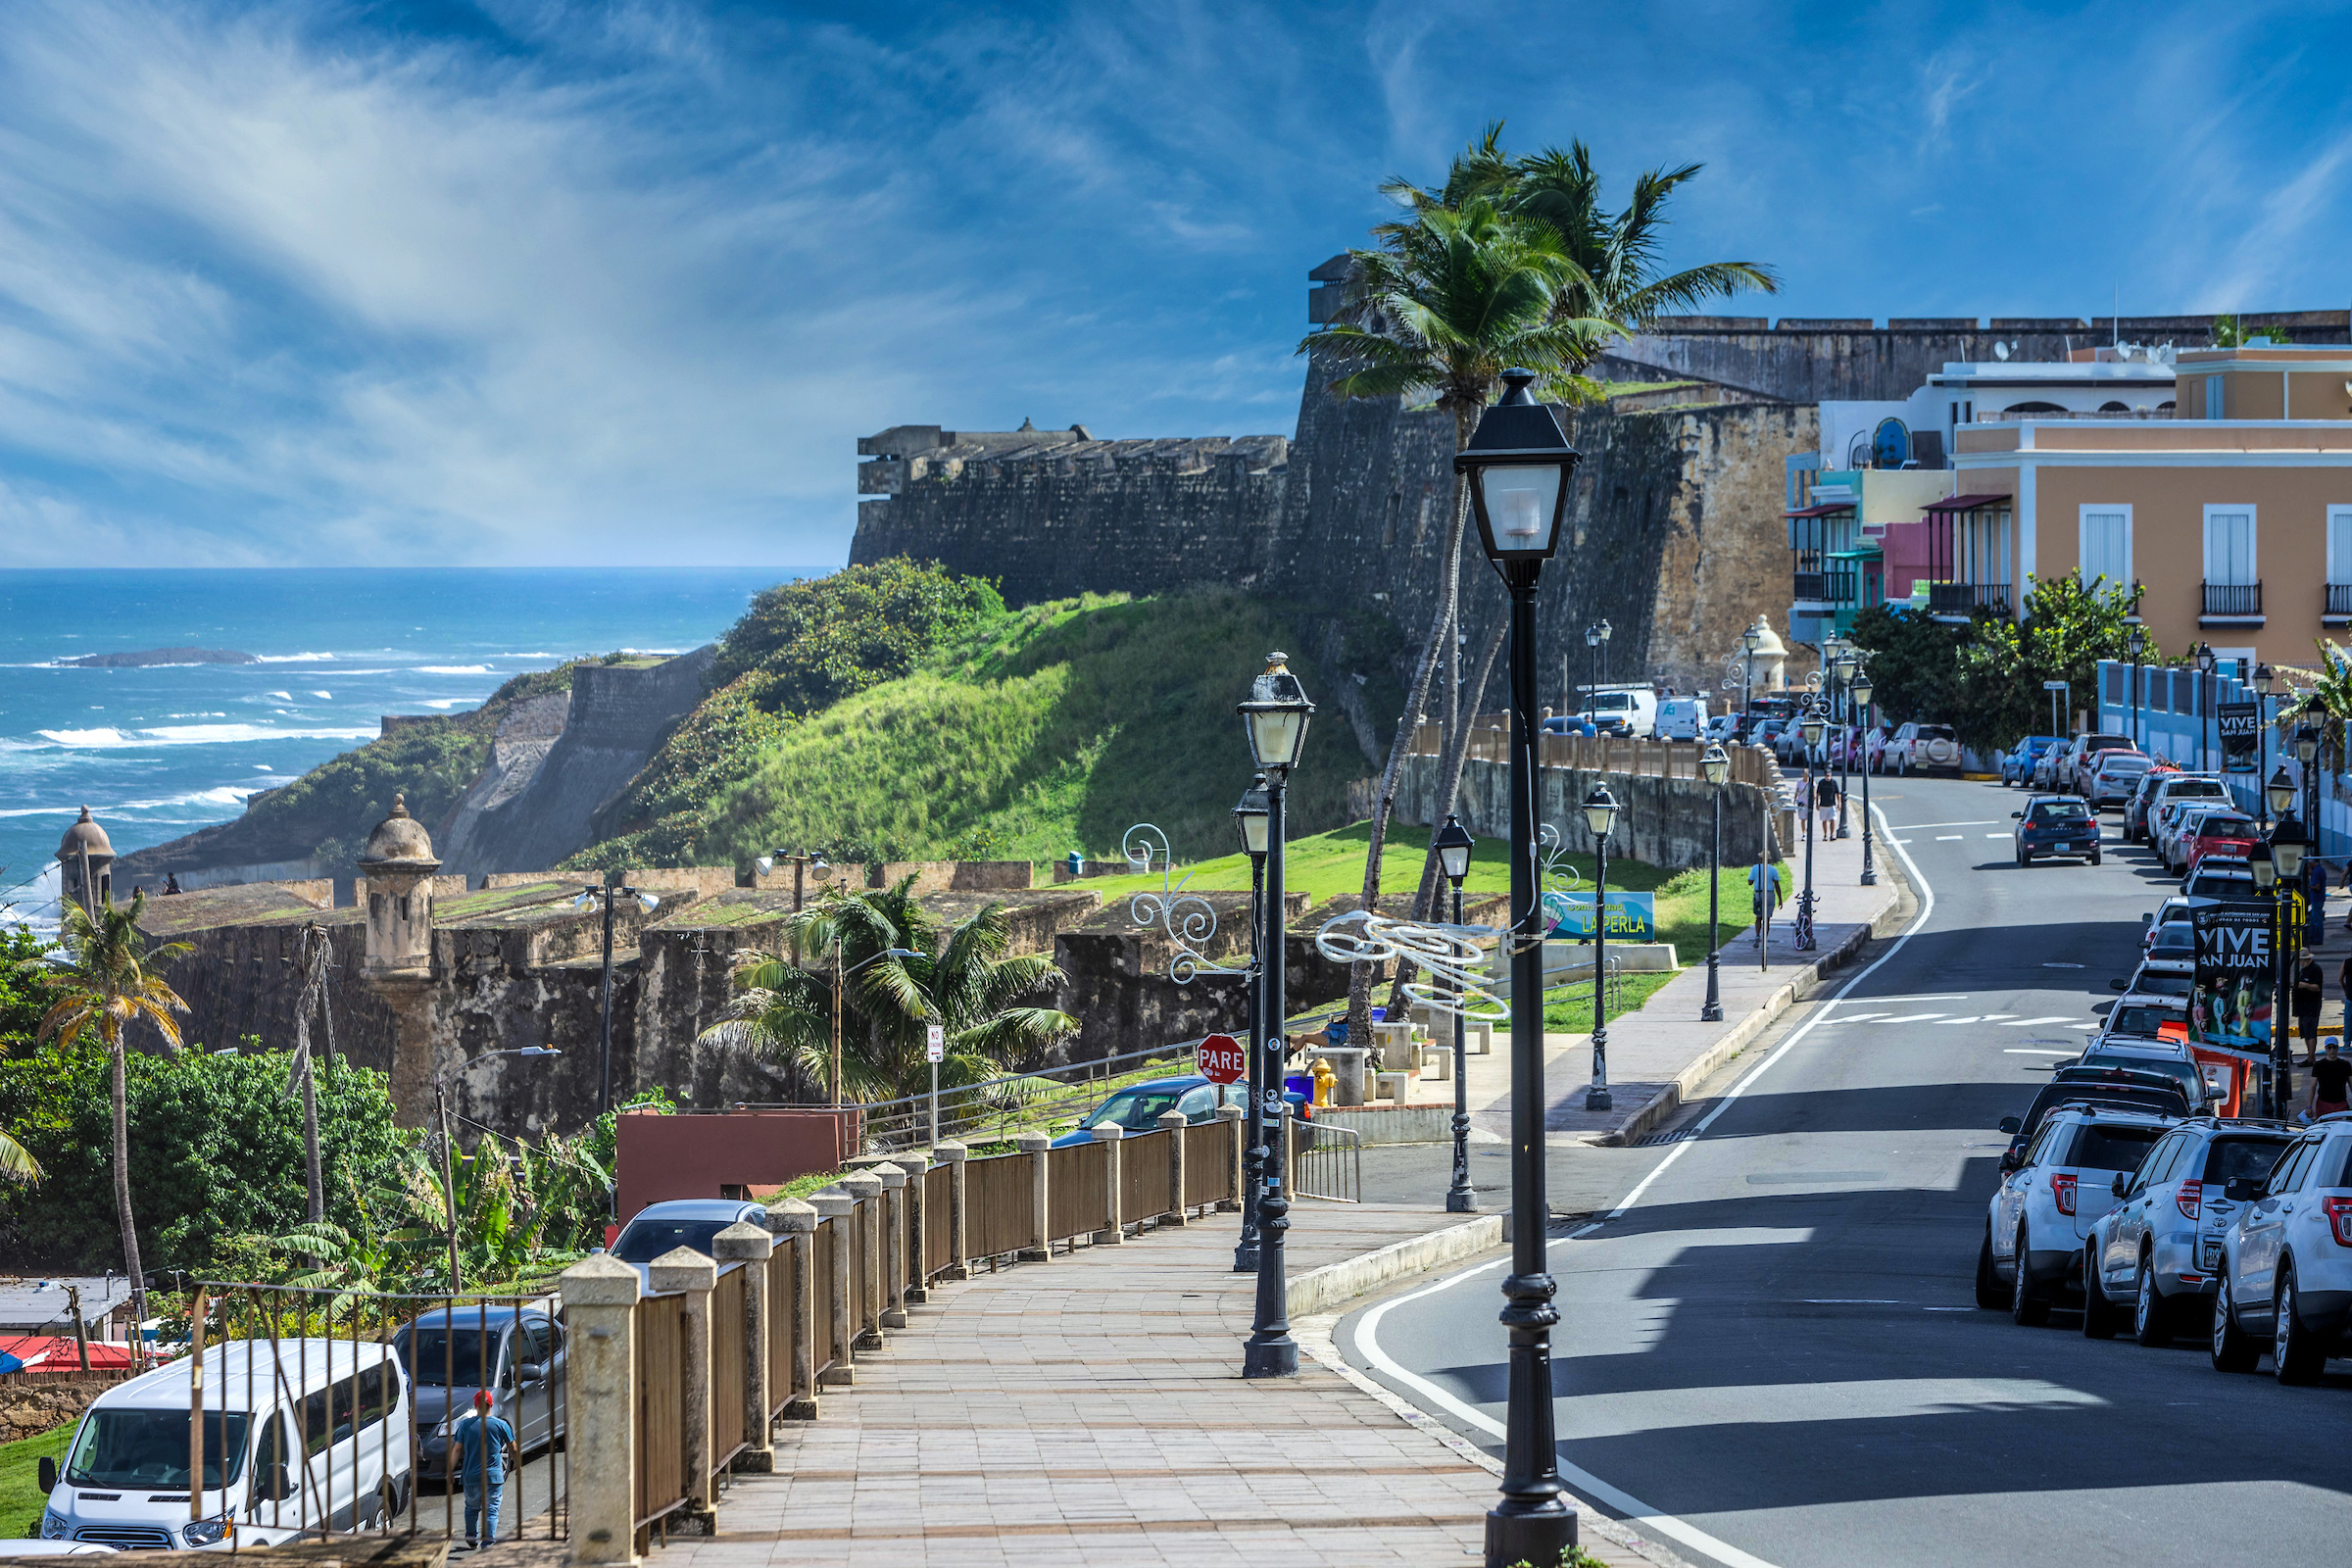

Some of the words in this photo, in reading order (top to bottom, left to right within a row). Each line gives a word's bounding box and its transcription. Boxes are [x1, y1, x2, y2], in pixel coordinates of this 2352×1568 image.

[2220, 716, 2255, 729] VIVE
[1582, 915, 1597, 933] LA
[1603, 915, 1645, 933] PERLA
[2198, 927, 2270, 954] VIVE
[2199, 954, 2223, 967] AN
[2226, 955, 2269, 967] JUAN
[931, 1031, 939, 1040] NO
[1200, 1049, 1243, 1070] PARE
